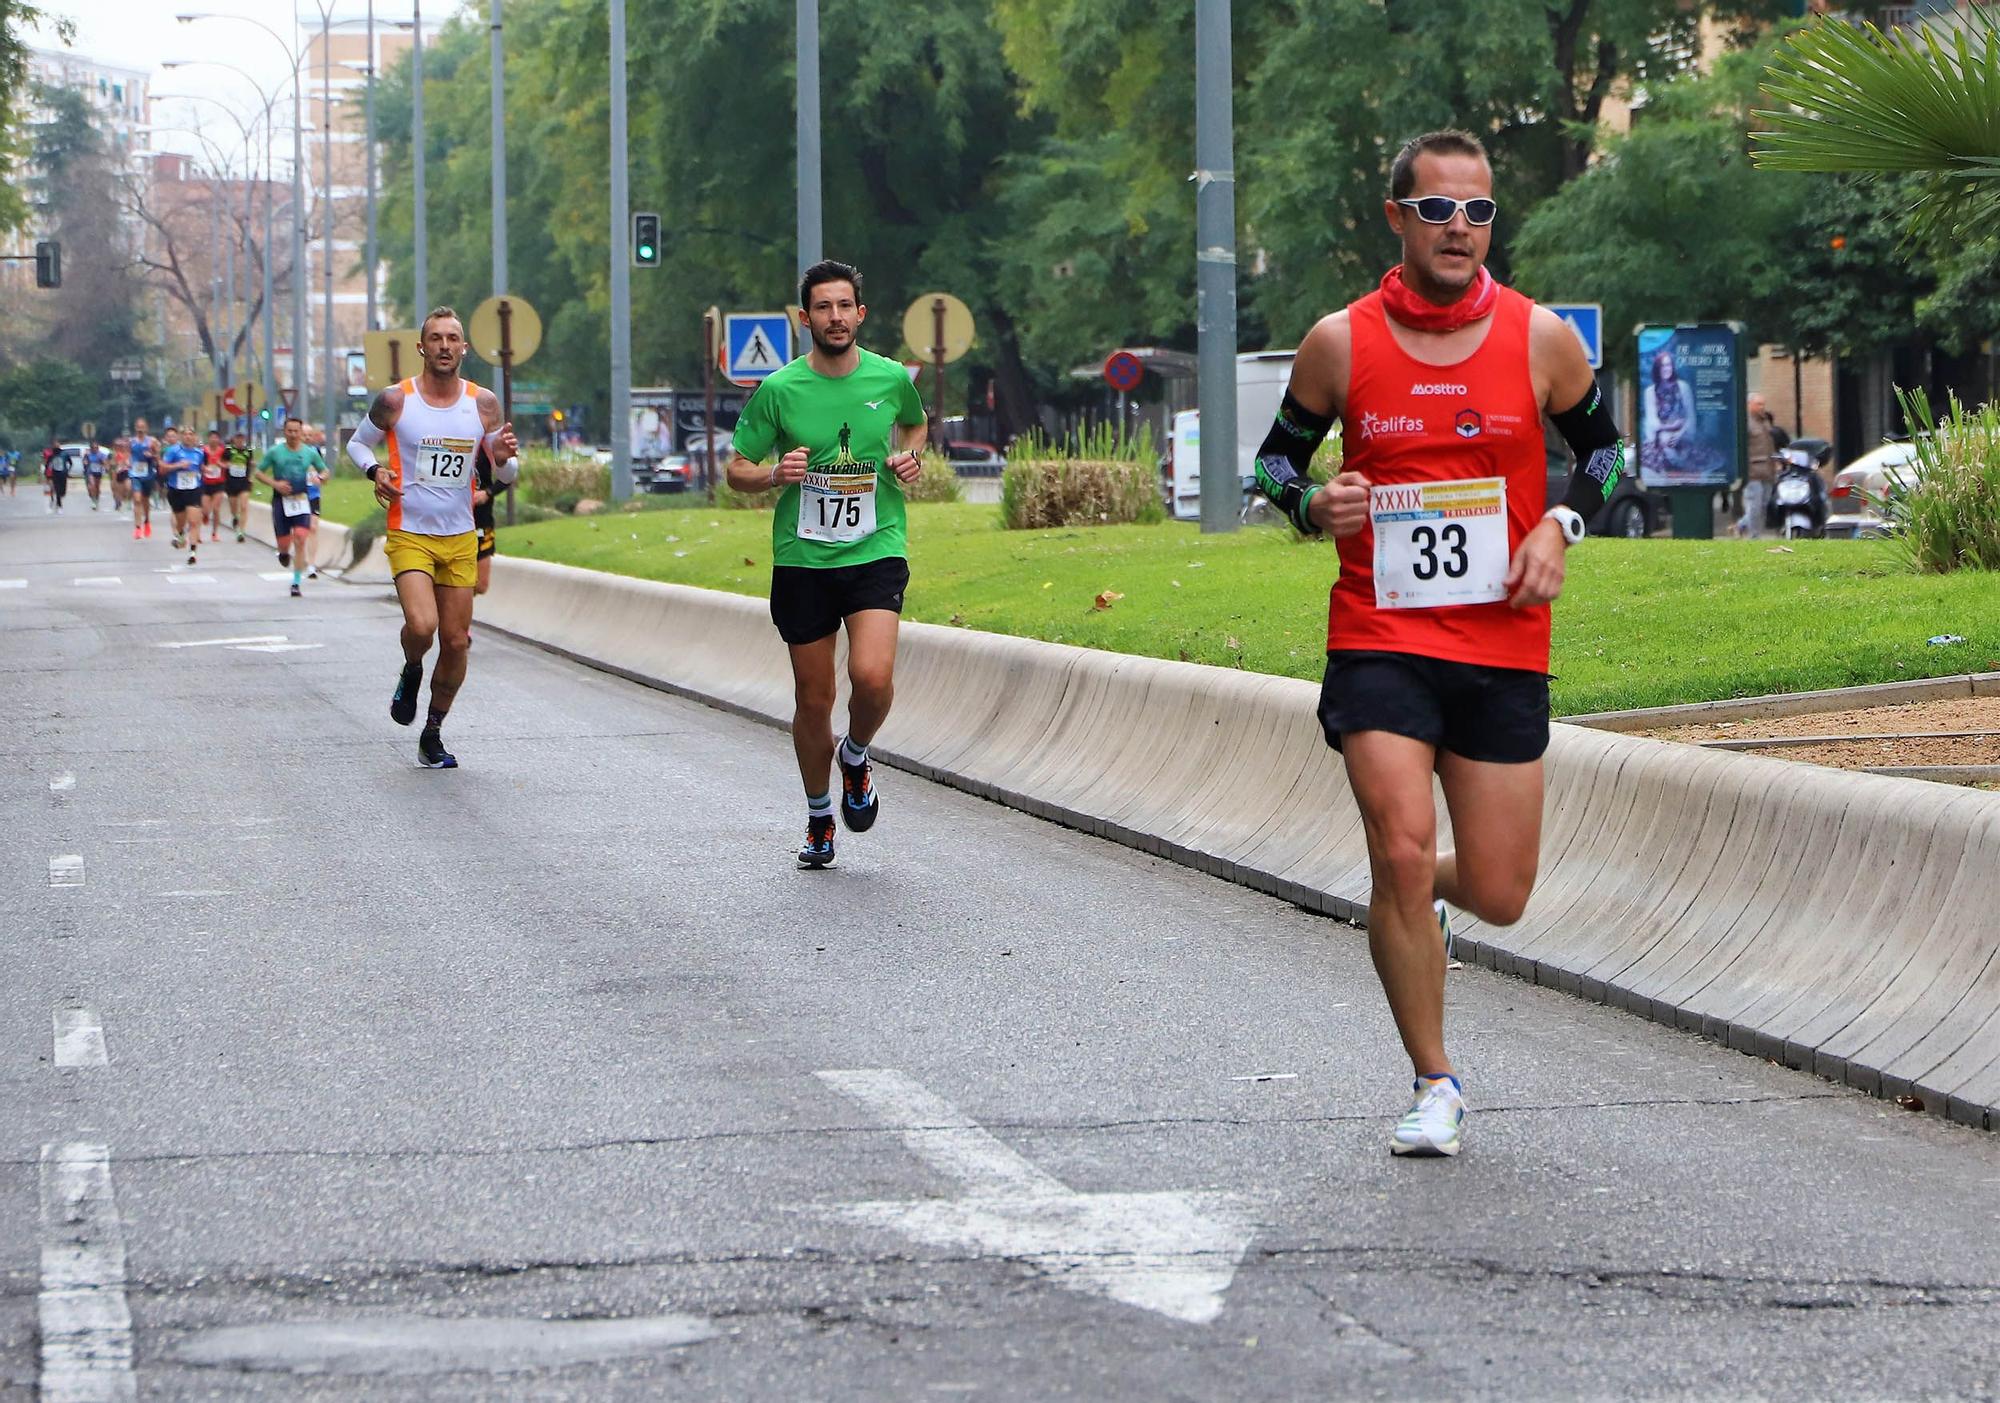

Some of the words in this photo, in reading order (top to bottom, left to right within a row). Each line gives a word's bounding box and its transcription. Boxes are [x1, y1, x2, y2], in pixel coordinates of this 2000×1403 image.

[1372, 415, 1424, 433] califas
[431, 453, 464, 478] 123
[1375, 488, 1422, 511] XXXIX
[817, 496, 860, 528] 175
[1445, 506, 1501, 518] TRINITARIOS
[1411, 523, 1469, 581] 33
